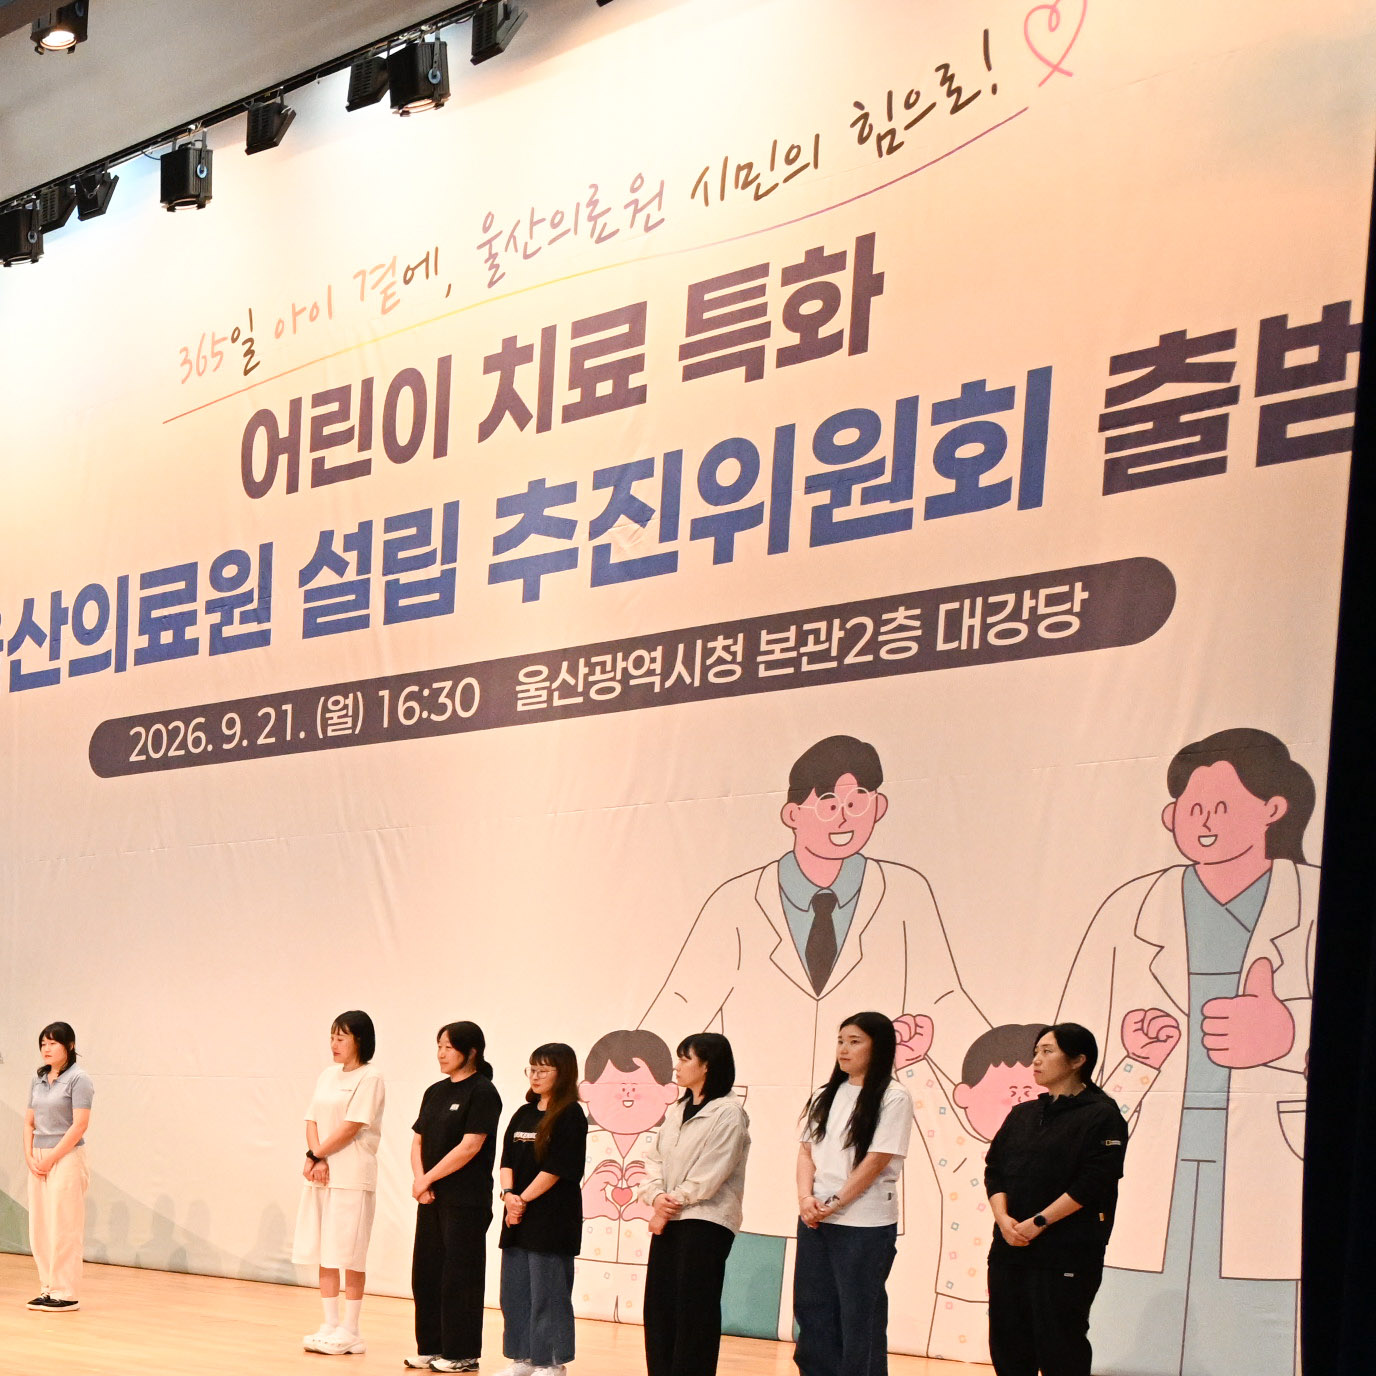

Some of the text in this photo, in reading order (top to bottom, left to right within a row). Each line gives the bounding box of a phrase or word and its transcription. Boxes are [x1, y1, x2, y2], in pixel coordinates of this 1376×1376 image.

[179, 28, 1001, 385] 365일 아이 곁에, 울산의료원 시민의 힘으로!
[240, 231, 886, 500] 어린이 치료 특화
[298, 498, 461, 640] 설립
[487, 365, 1054, 605] 추진위원회
[128, 580, 1089, 763] 2026. 9. 21. (월) 16:30 울산광역시청 본관2층 대강당
